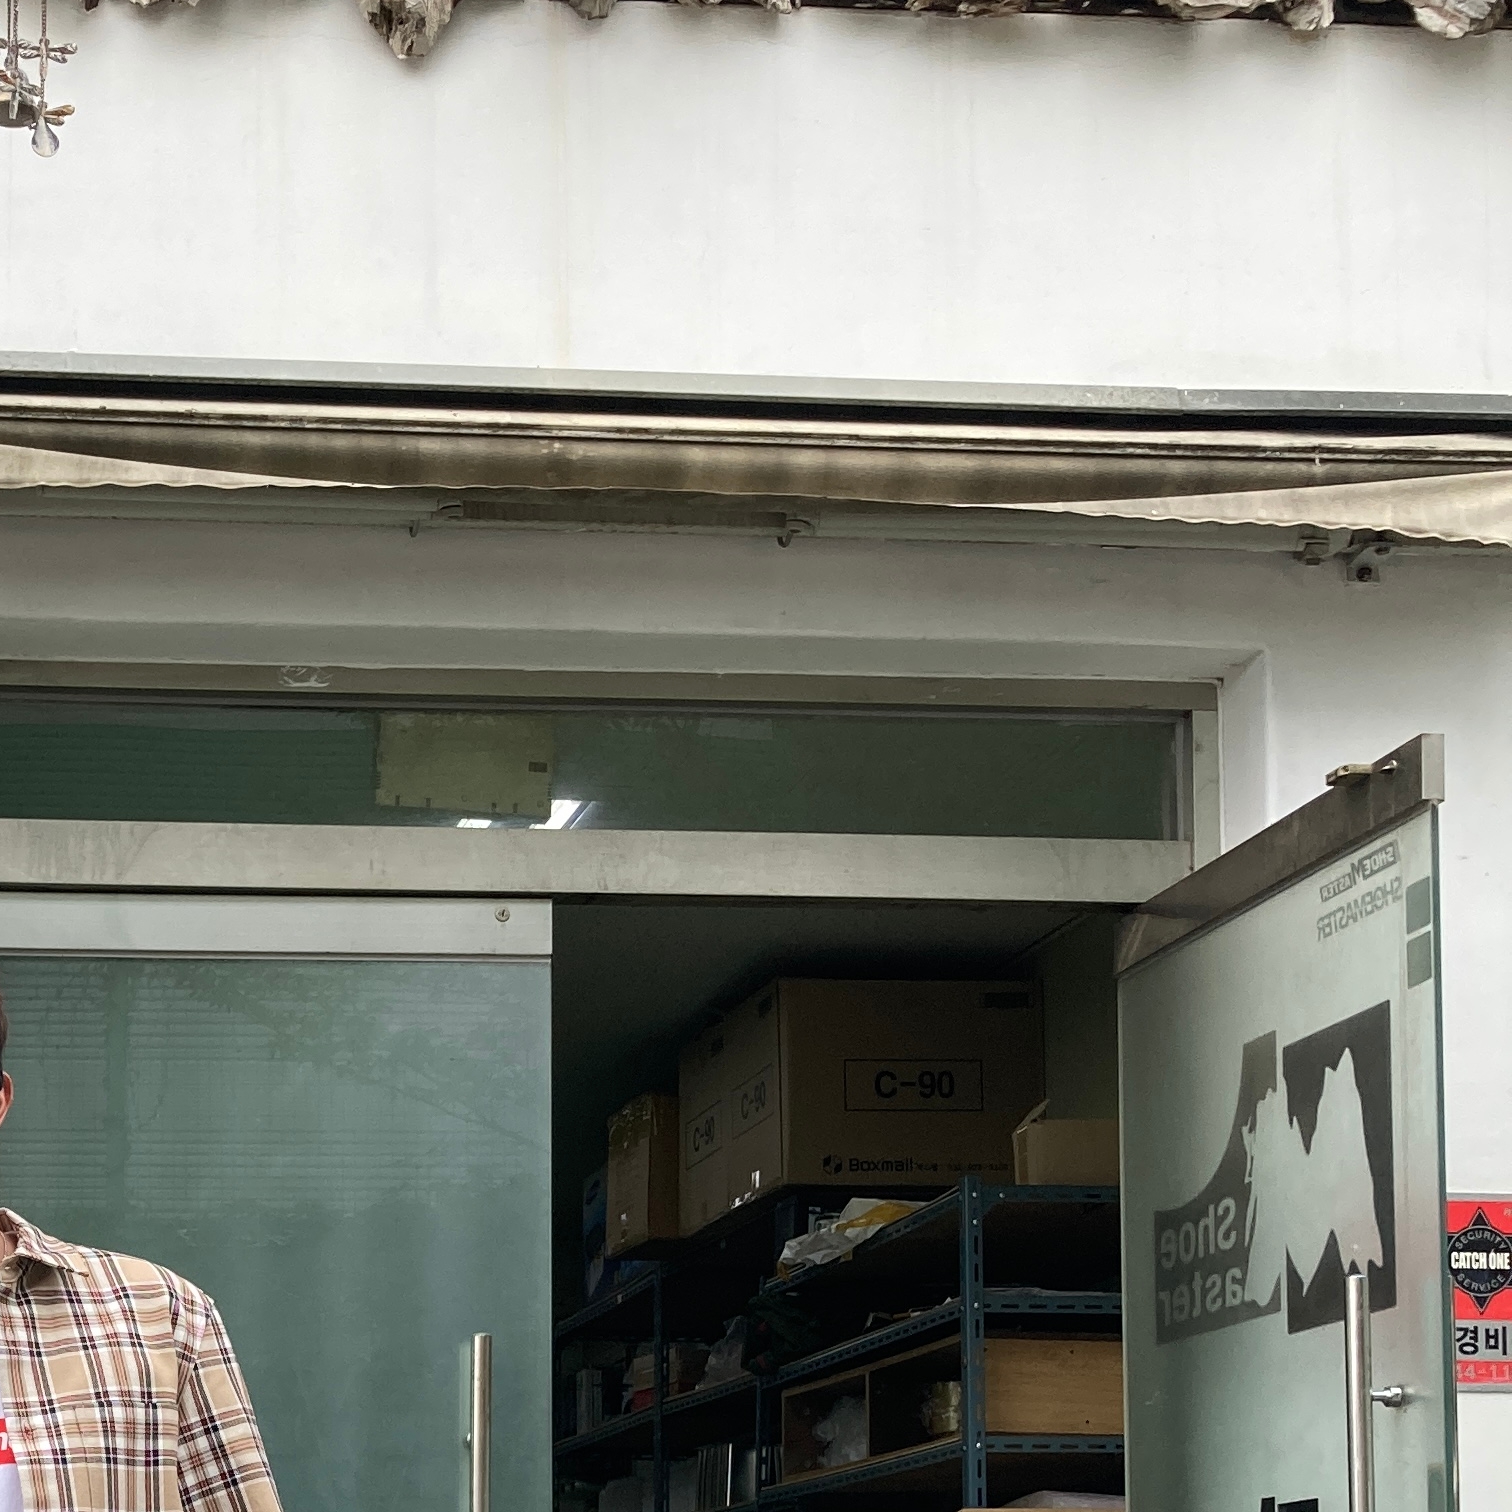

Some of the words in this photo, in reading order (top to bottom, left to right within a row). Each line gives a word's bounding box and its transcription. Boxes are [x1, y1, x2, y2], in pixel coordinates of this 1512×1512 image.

[874, 1070, 955, 1099] C-90
[741, 1081, 766, 1120] C-90
[693, 1116, 715, 1152] C-90
[849, 1157, 913, 1173] Boxmail
[1454, 1231, 1508, 1250] SECURITY
[1451, 1252, 1487, 1270] CATCH
[1489, 1250, 1511, 1270] ONE
[1456, 1273, 1506, 1293] SERVICE
[1455, 1325, 1508, 1356] 경비
